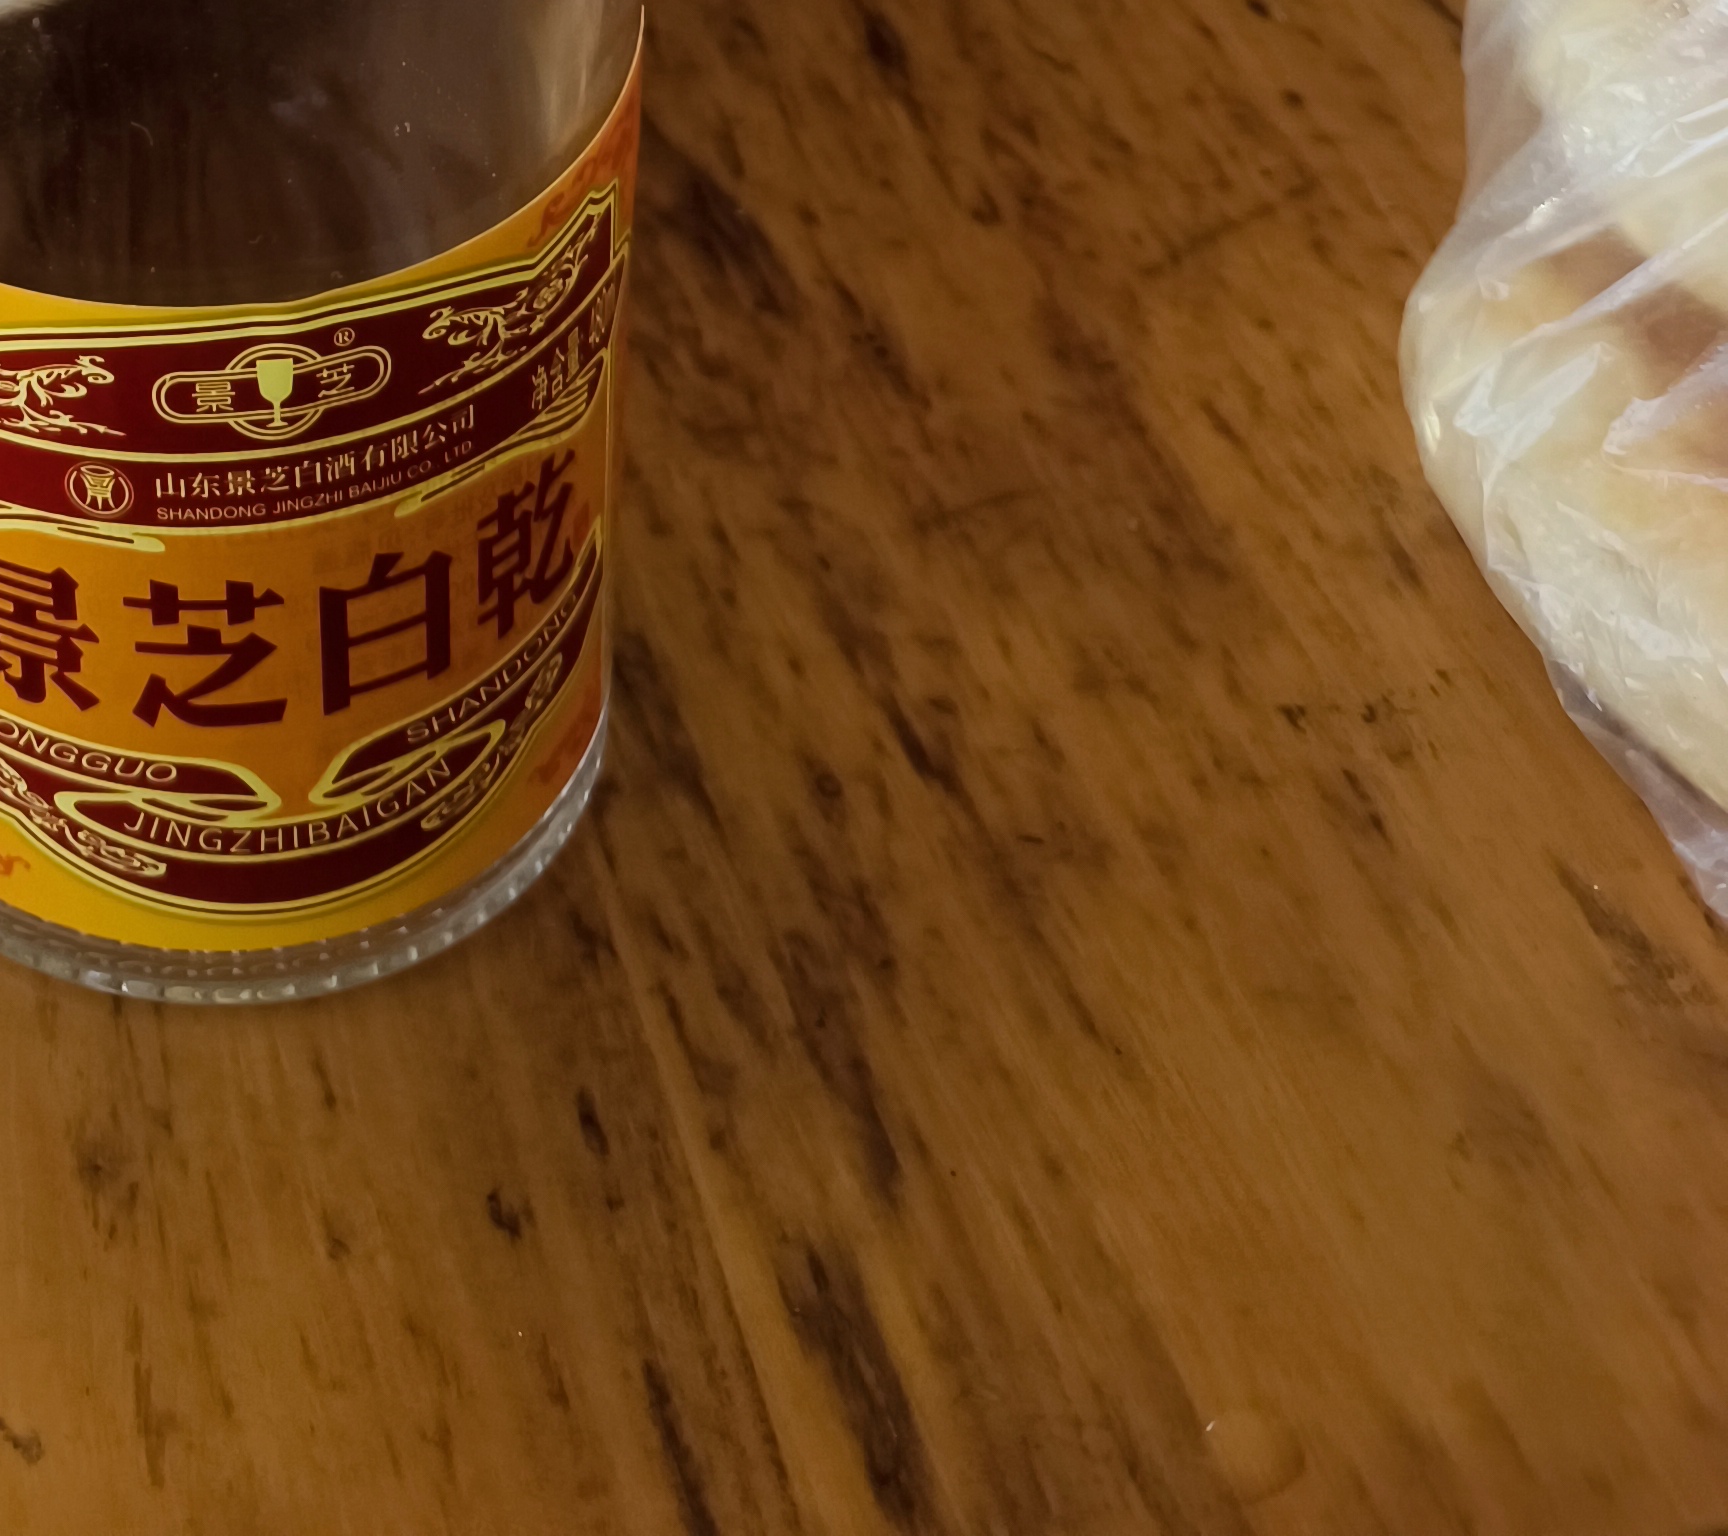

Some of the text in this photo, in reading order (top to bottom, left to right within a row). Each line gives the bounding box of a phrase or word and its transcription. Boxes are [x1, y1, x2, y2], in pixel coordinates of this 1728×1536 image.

[154, 404, 476, 499] 山东景芝白酒有限公司
[156, 502, 267, 521] SHANDONG
[272, 489, 344, 515] JINGZHI
[348, 471, 403, 500] BAIJIU
[405, 591, 578, 747] SHANDONG
[122, 755, 454, 855] JINGZHIBAIGAN
